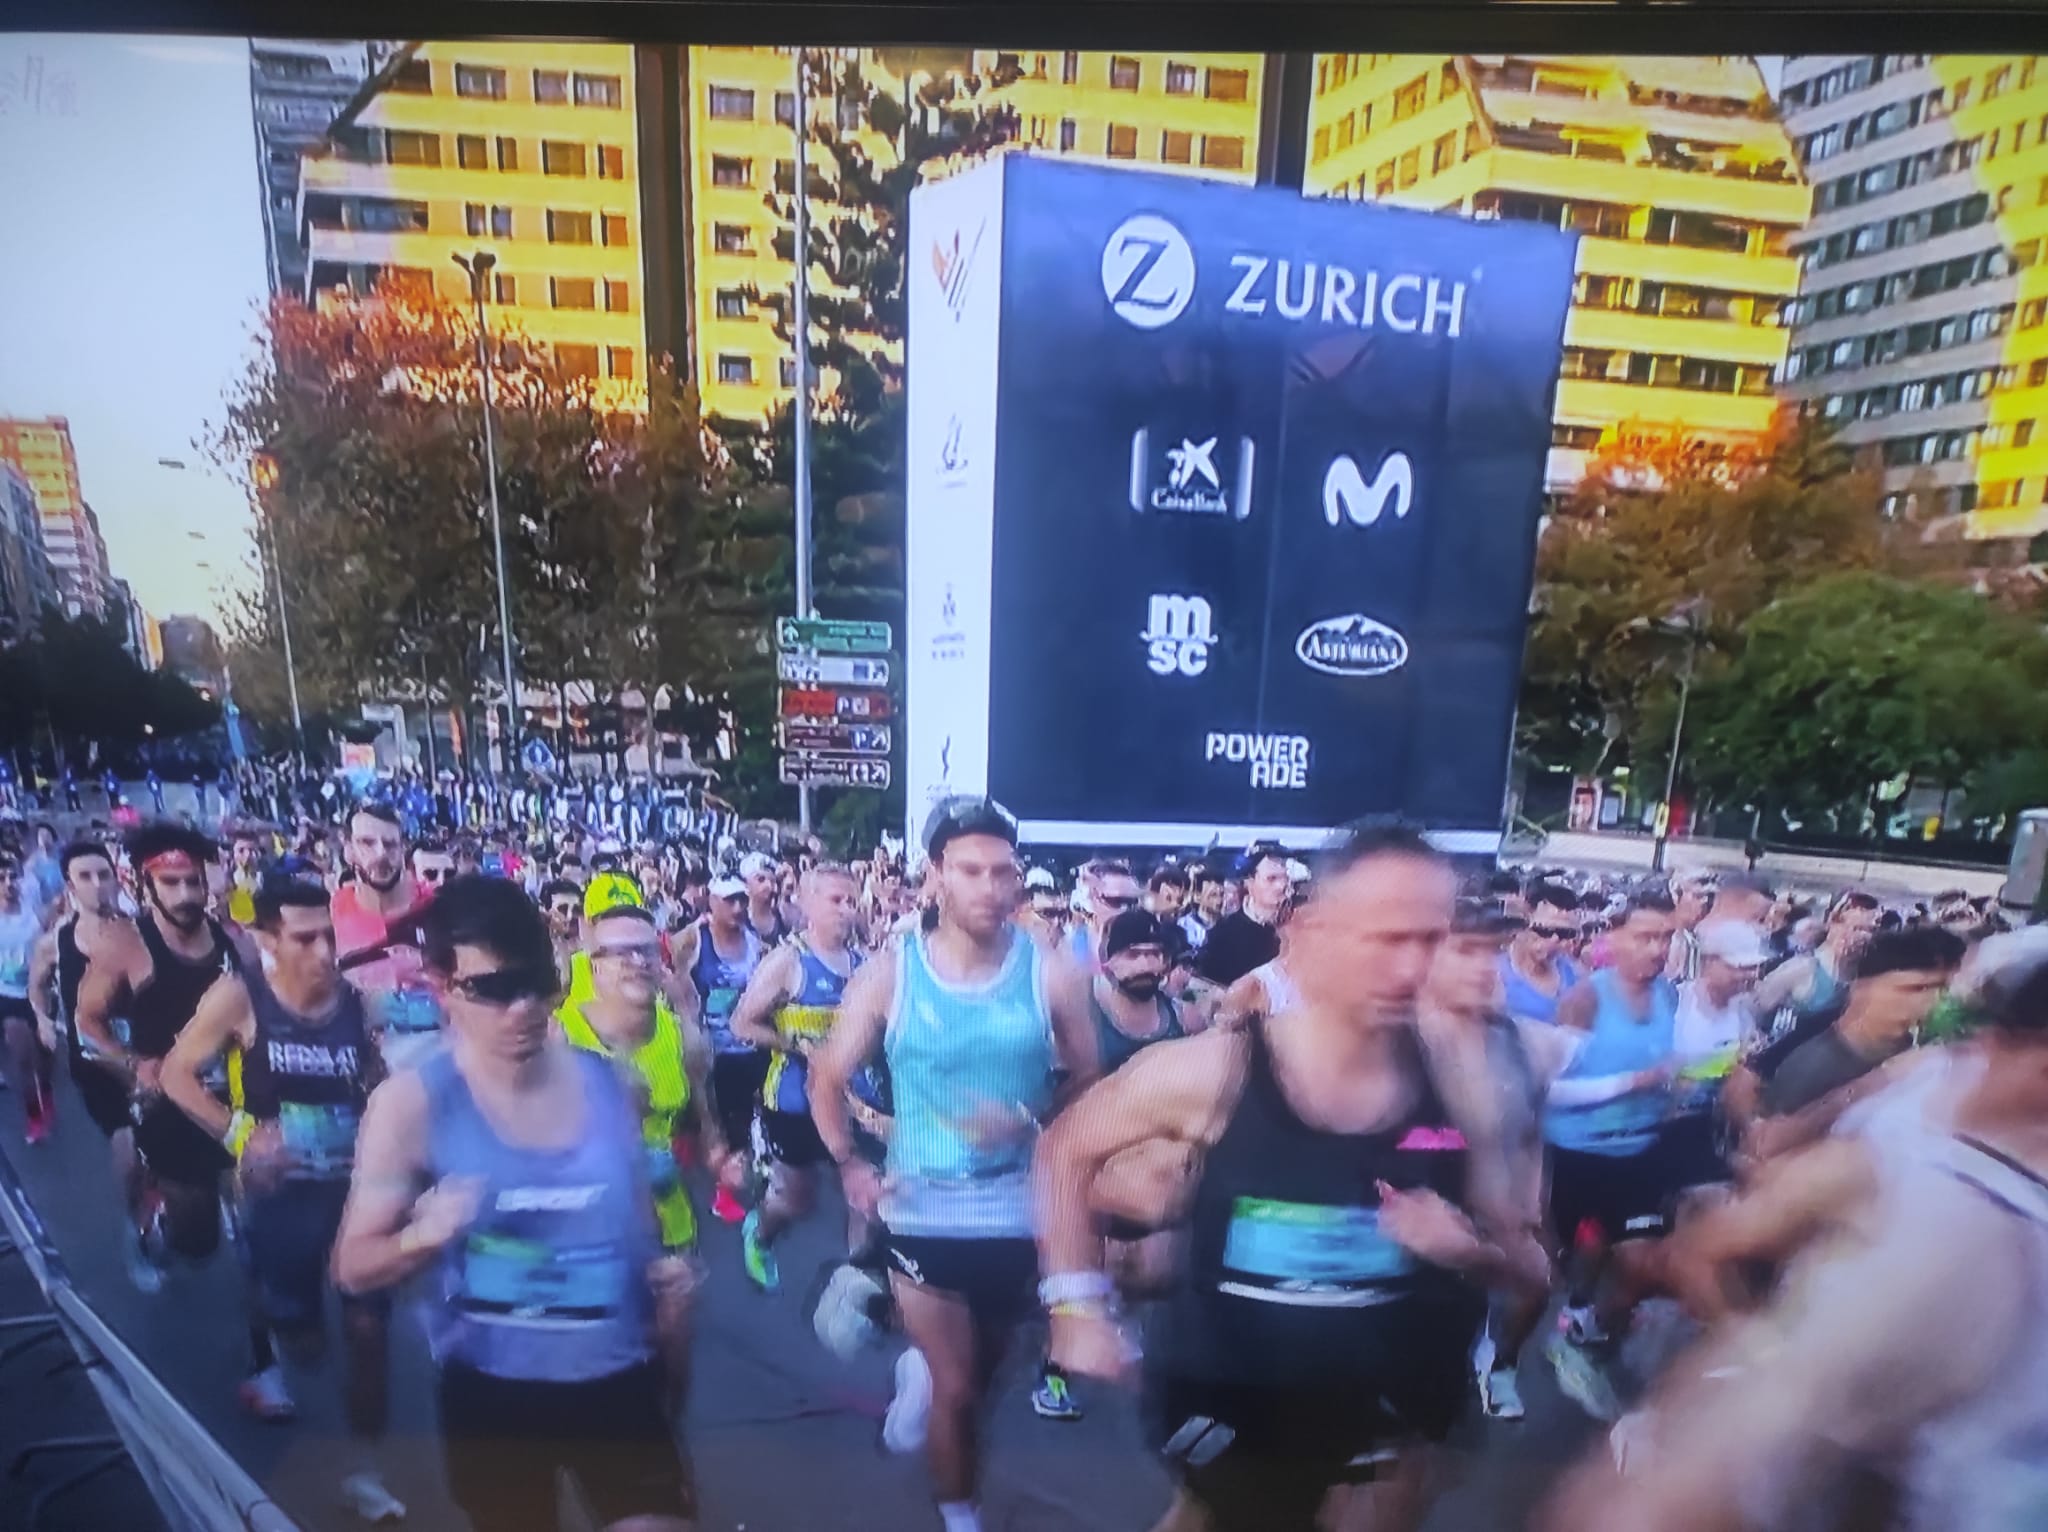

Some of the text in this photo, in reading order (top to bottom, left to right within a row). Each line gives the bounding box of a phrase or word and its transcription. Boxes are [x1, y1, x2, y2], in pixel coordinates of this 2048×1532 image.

[1224, 254, 1466, 338] ZURICH
[1205, 732, 1310, 769] POWER
[1250, 760, 1307, 788] ADE
